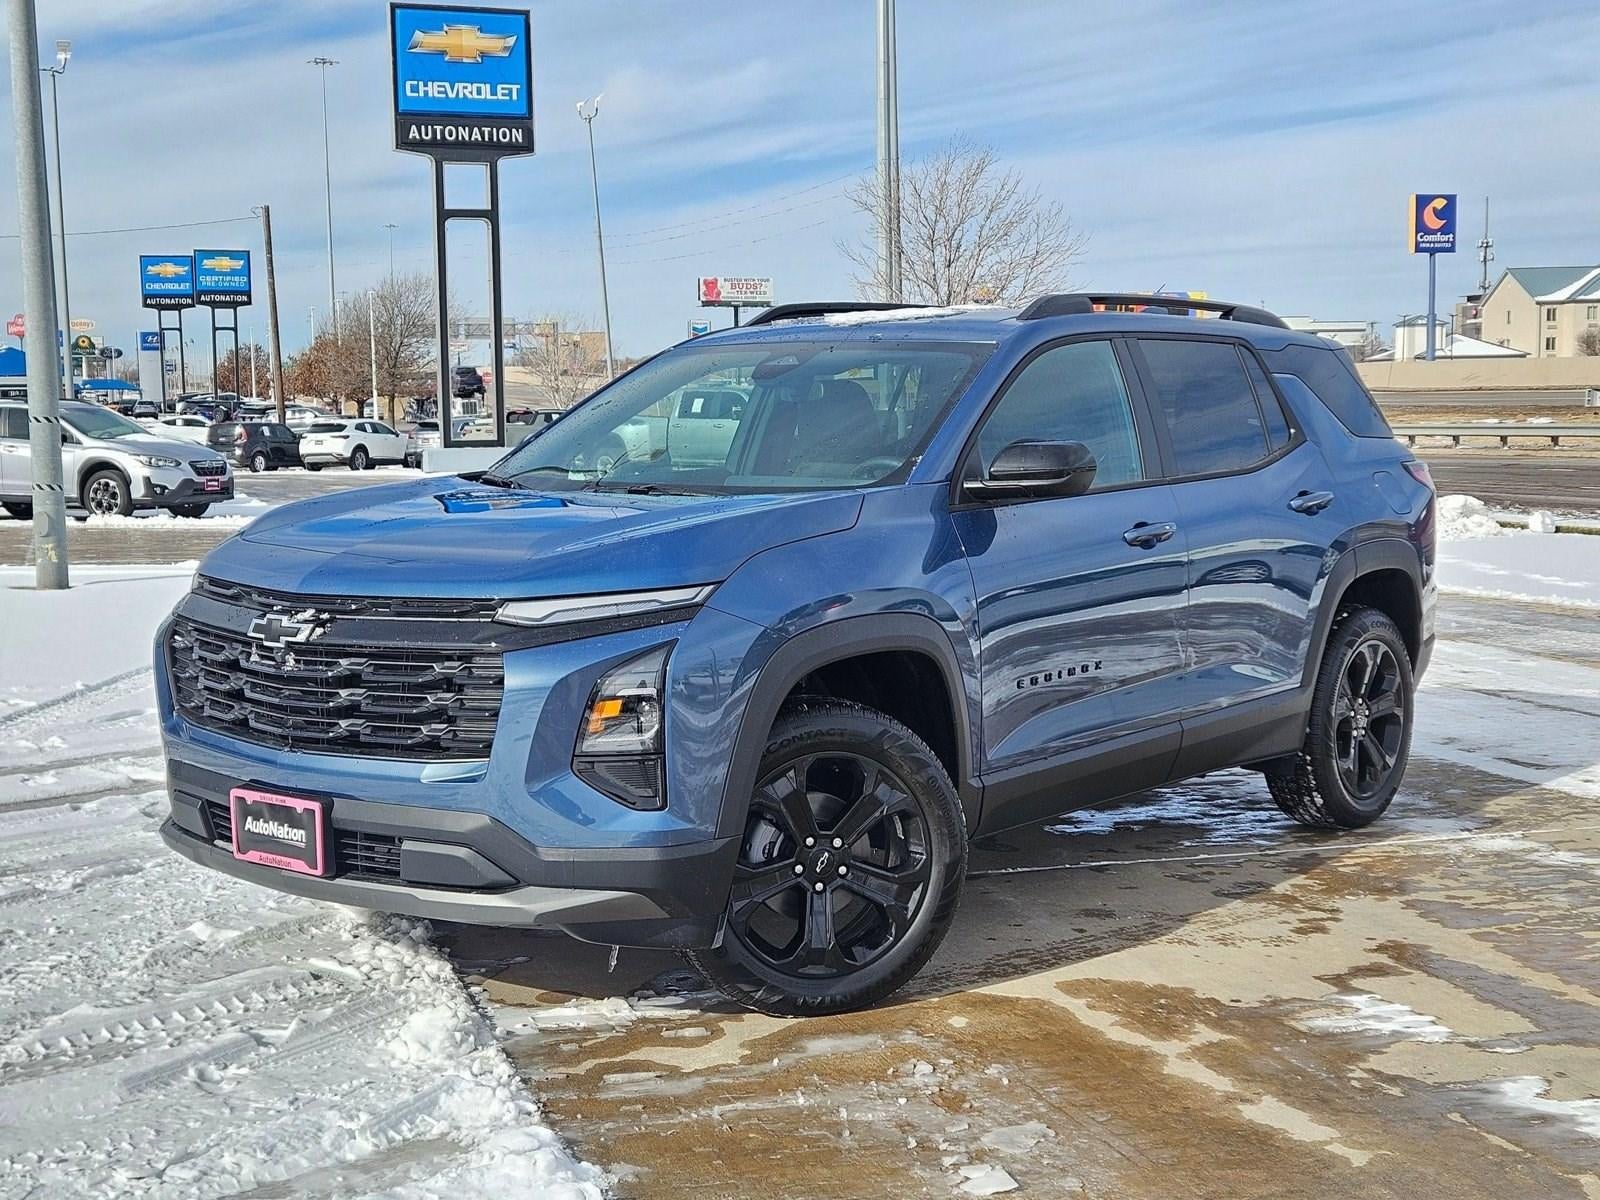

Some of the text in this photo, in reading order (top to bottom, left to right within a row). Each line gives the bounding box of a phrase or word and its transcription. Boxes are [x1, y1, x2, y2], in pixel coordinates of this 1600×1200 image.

[405, 80, 521, 100] CHEVROLET
[408, 124, 523, 143] AUTONATION
[1417, 232, 1454, 242] Comfort
[145, 282, 190, 290] CHEVROLET
[730, 282, 763, 290] BUDS?
[146, 297, 192, 305] AUTONATION
[200, 294, 248, 302] AUTONATION
[1016, 660, 1102, 689] EQUINOX
[244, 816, 306, 842] AutoNation
[259, 855, 292, 868] AutoNation
